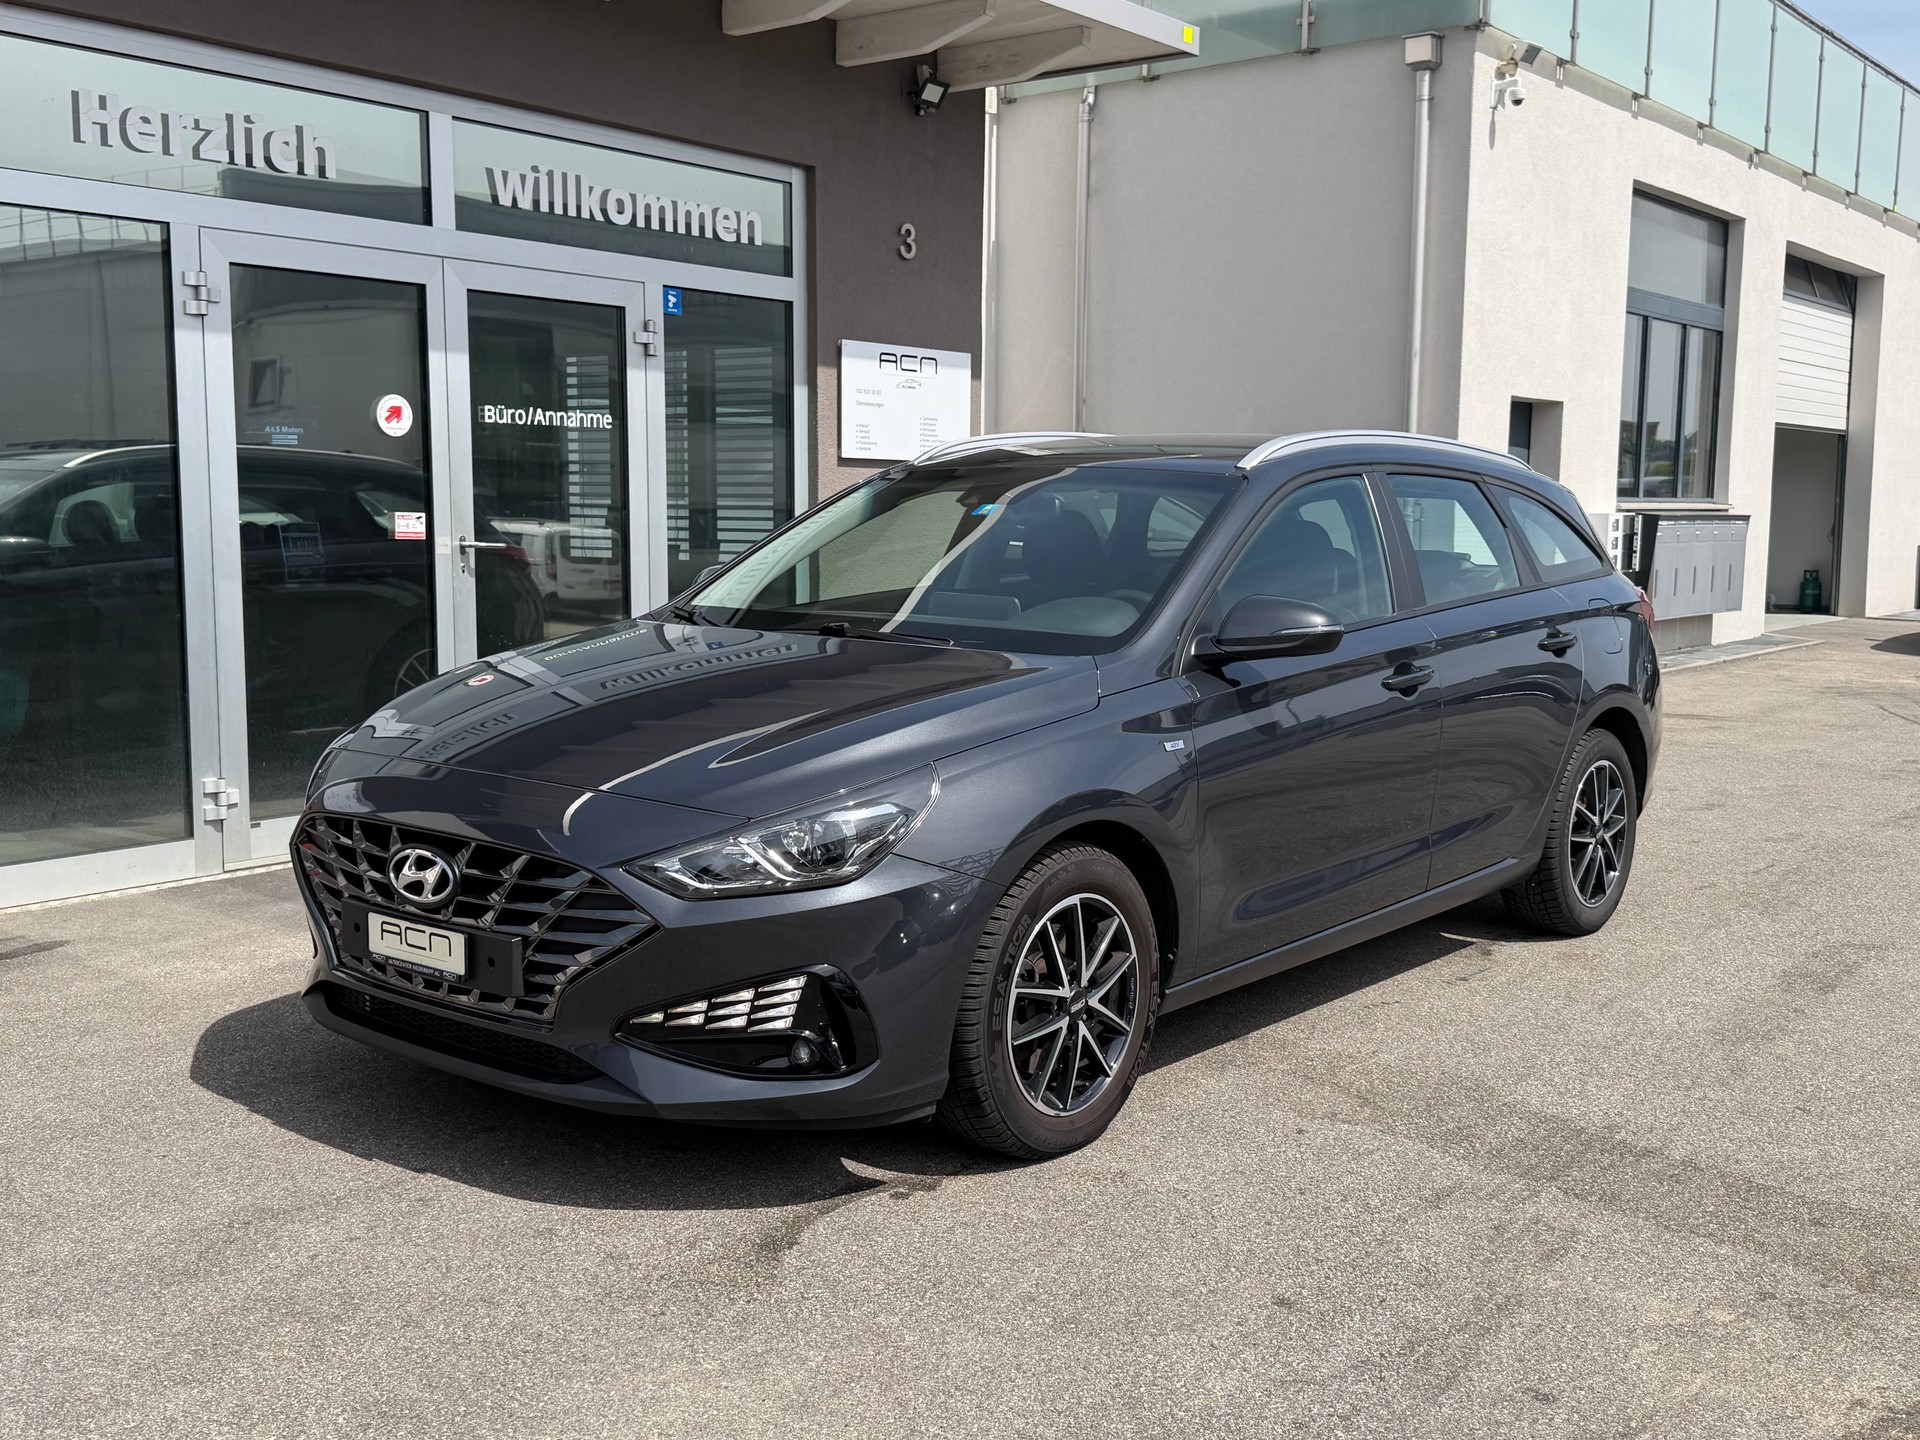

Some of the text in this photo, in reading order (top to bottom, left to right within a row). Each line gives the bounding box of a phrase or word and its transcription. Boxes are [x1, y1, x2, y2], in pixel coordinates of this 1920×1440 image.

[76, 88, 337, 179] Herzlich
[490, 165, 763, 246] willkommen
[900, 223, 917, 259] 3
[878, 352, 938, 375] ACN
[484, 405, 613, 429] Büro/Annahme
[380, 920, 452, 957] ACN
[1003, 913, 1032, 965] TECAR
